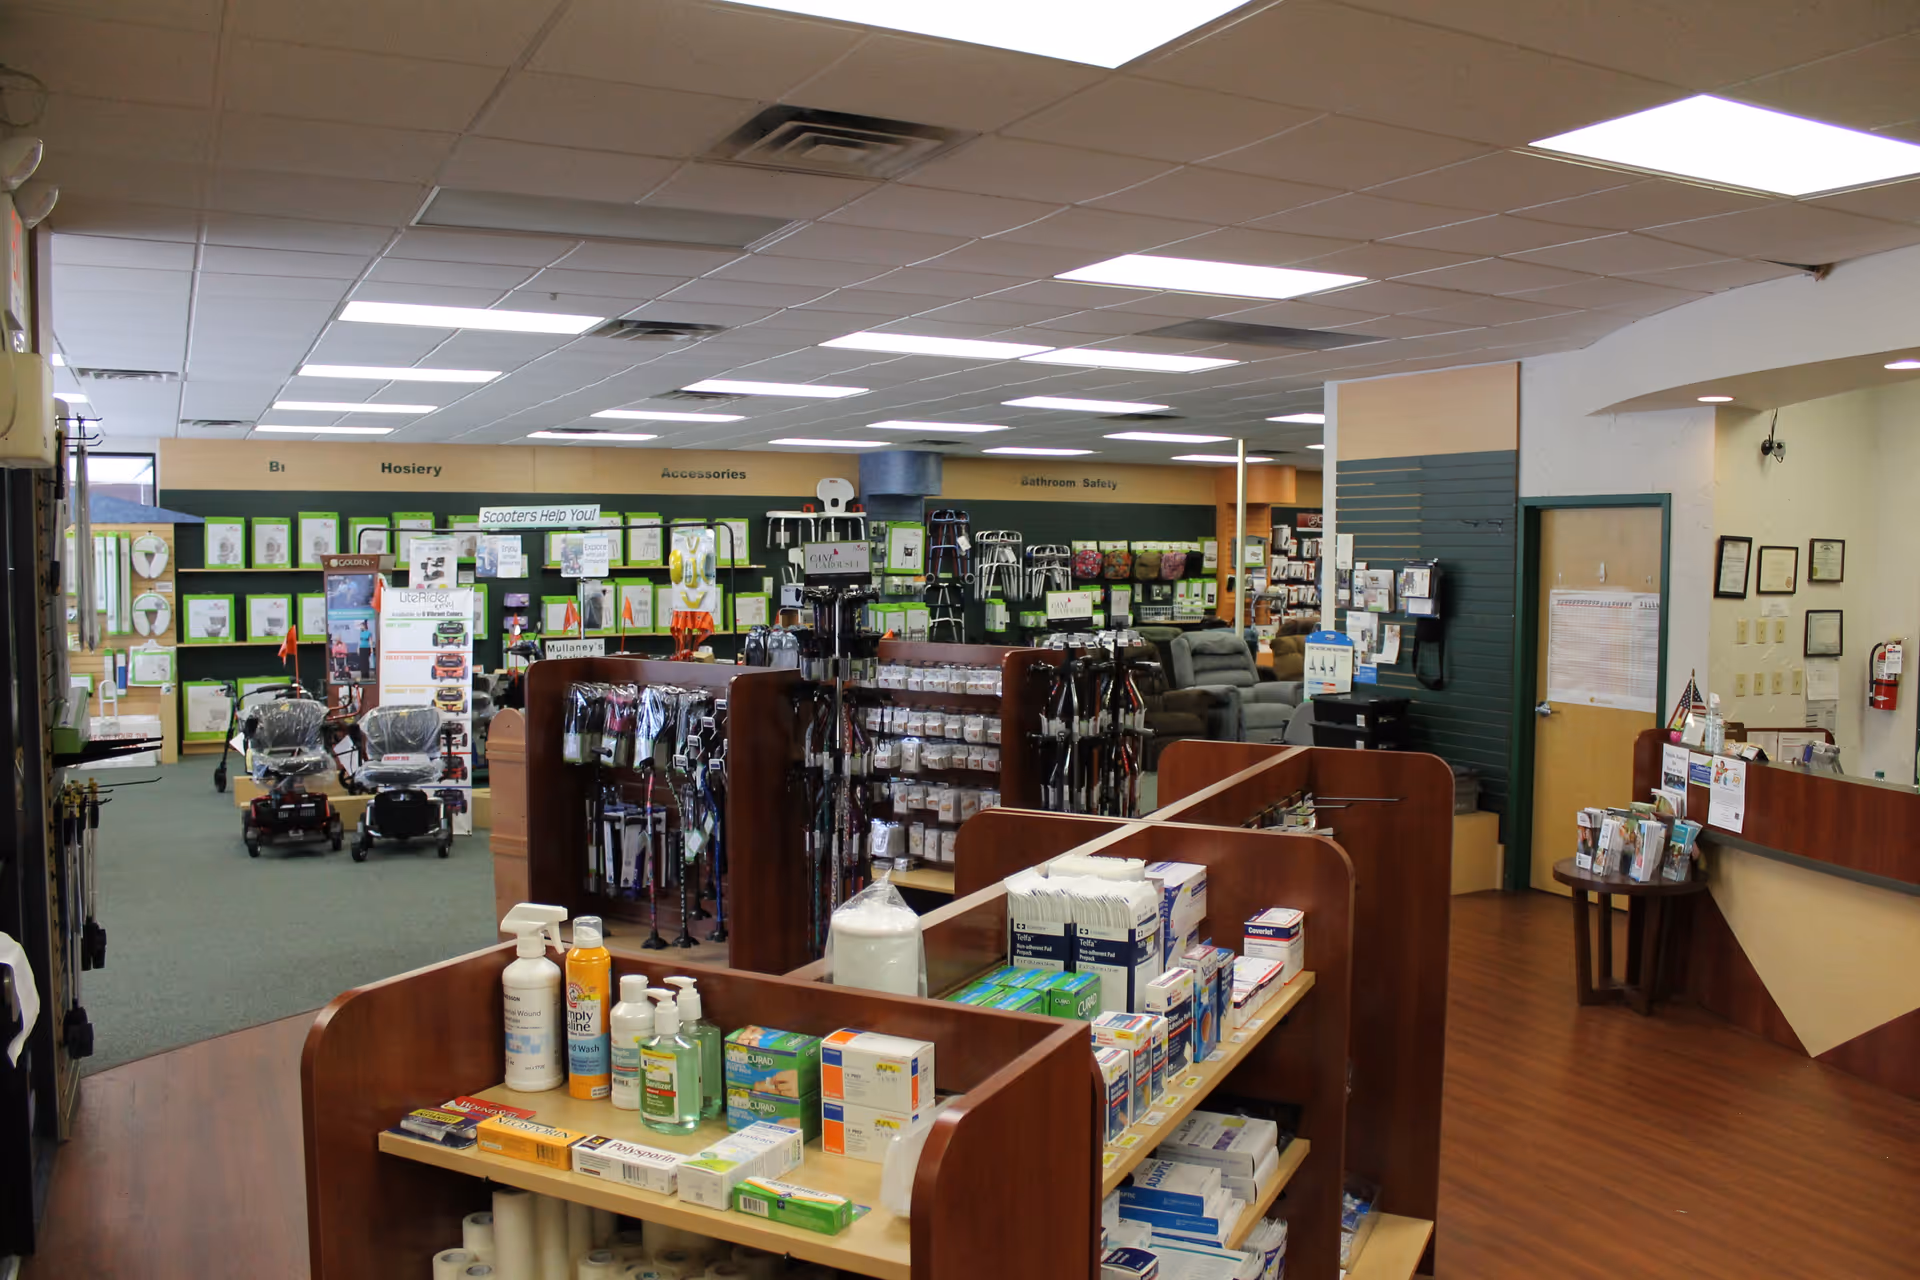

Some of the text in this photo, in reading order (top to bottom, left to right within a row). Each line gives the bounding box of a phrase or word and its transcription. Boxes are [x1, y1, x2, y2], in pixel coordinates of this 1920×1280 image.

[381, 462, 442, 477] Hosiery
[661, 468, 747, 480] Accessories
[1021, 476, 1076, 488] Bathroom
[1082, 478, 1118, 491] Safety
[482, 508, 596, 523] Scooters Help You!
[338, 559, 370, 567] GOLDEN
[810, 553, 833, 563] CANE
[400, 591, 449, 603] LiteRider
[547, 642, 603, 653] Mullaney's
[1248, 927, 1274, 936] Coverlet
[1077, 992, 1098, 1017] CURAD
[579, 1044, 600, 1053] Wash
[747, 1053, 774, 1066] CURAD
[645, 1079, 672, 1091] Sanitizer
[748, 1100, 776, 1113] CURAD
[494, 1116, 573, 1139] NEOSPORIN
[608, 1141, 676, 1164] Polysporin
[1145, 1160, 1174, 1188] ADAPTIC
